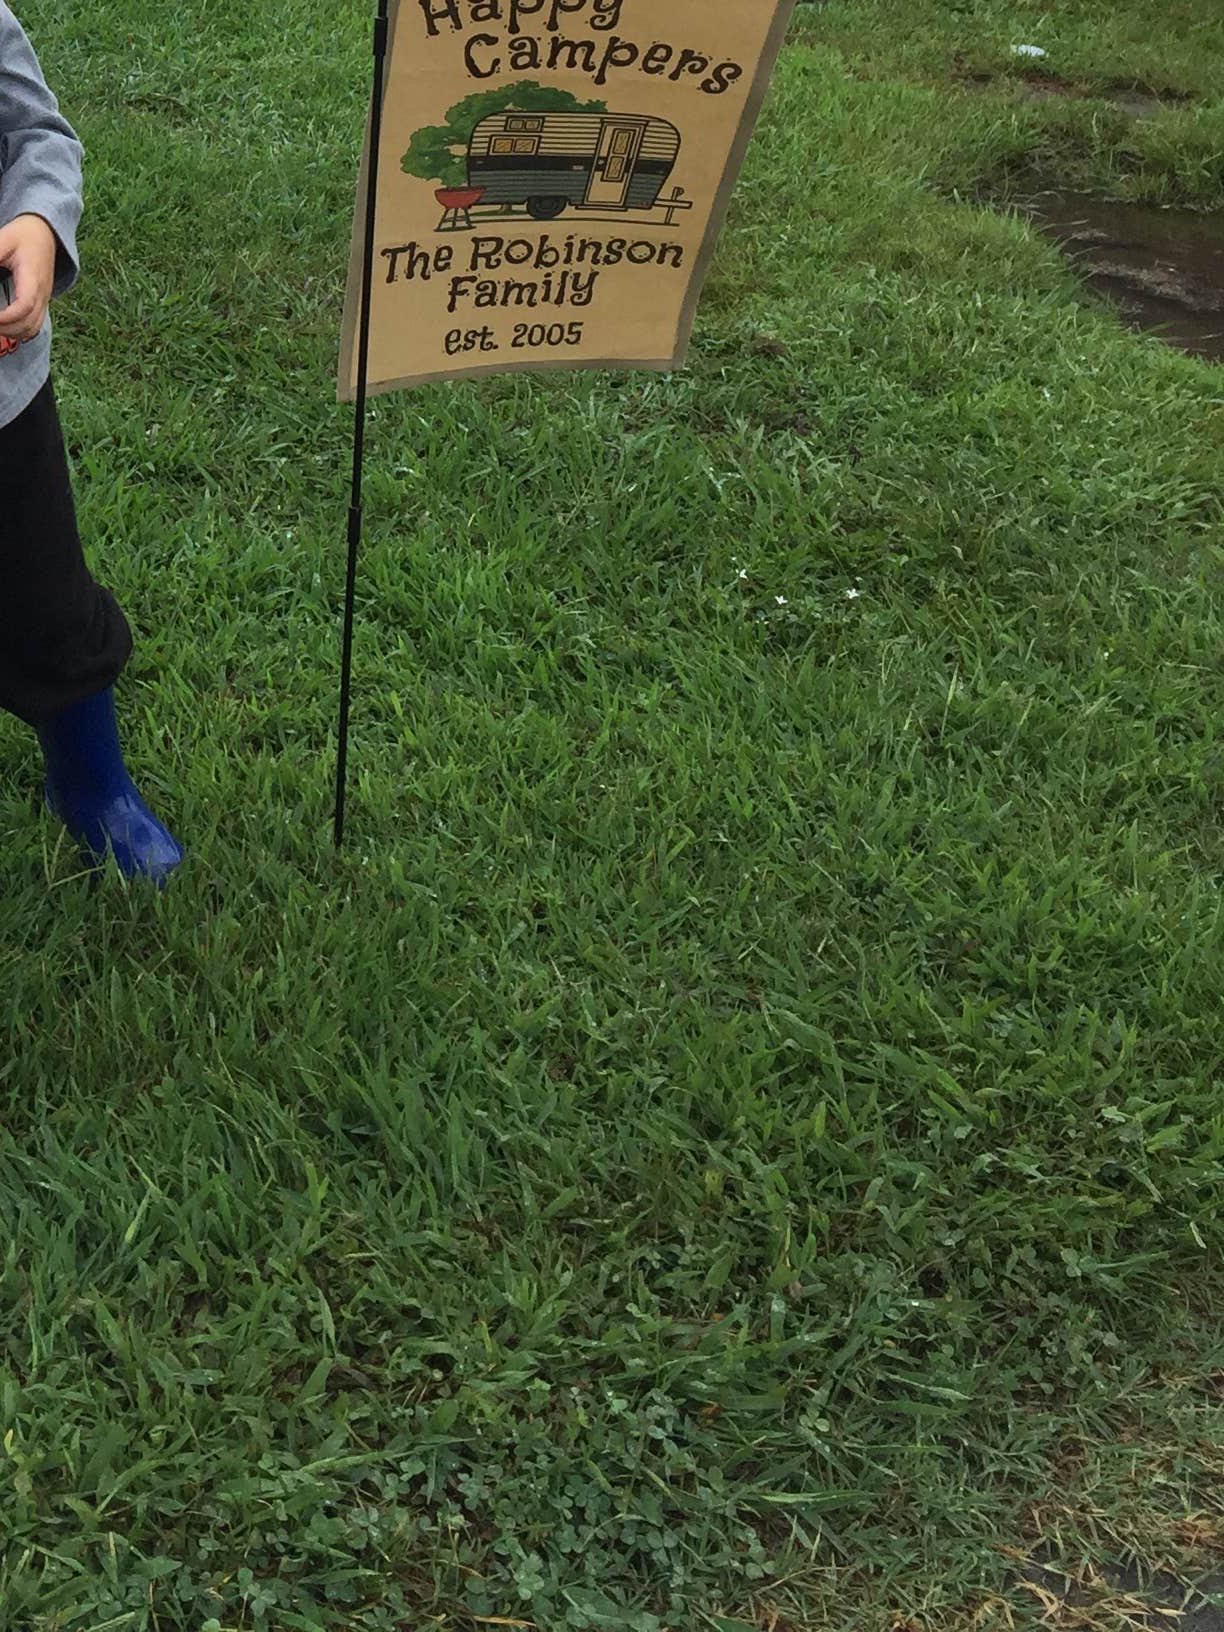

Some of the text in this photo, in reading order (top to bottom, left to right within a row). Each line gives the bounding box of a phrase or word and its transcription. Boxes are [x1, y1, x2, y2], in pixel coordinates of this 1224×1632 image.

[463, 33, 743, 95] Campers
[380, 233, 684, 284] The Robinson
[447, 270, 600, 314] Family
[443, 321, 584, 356] est. 2005
